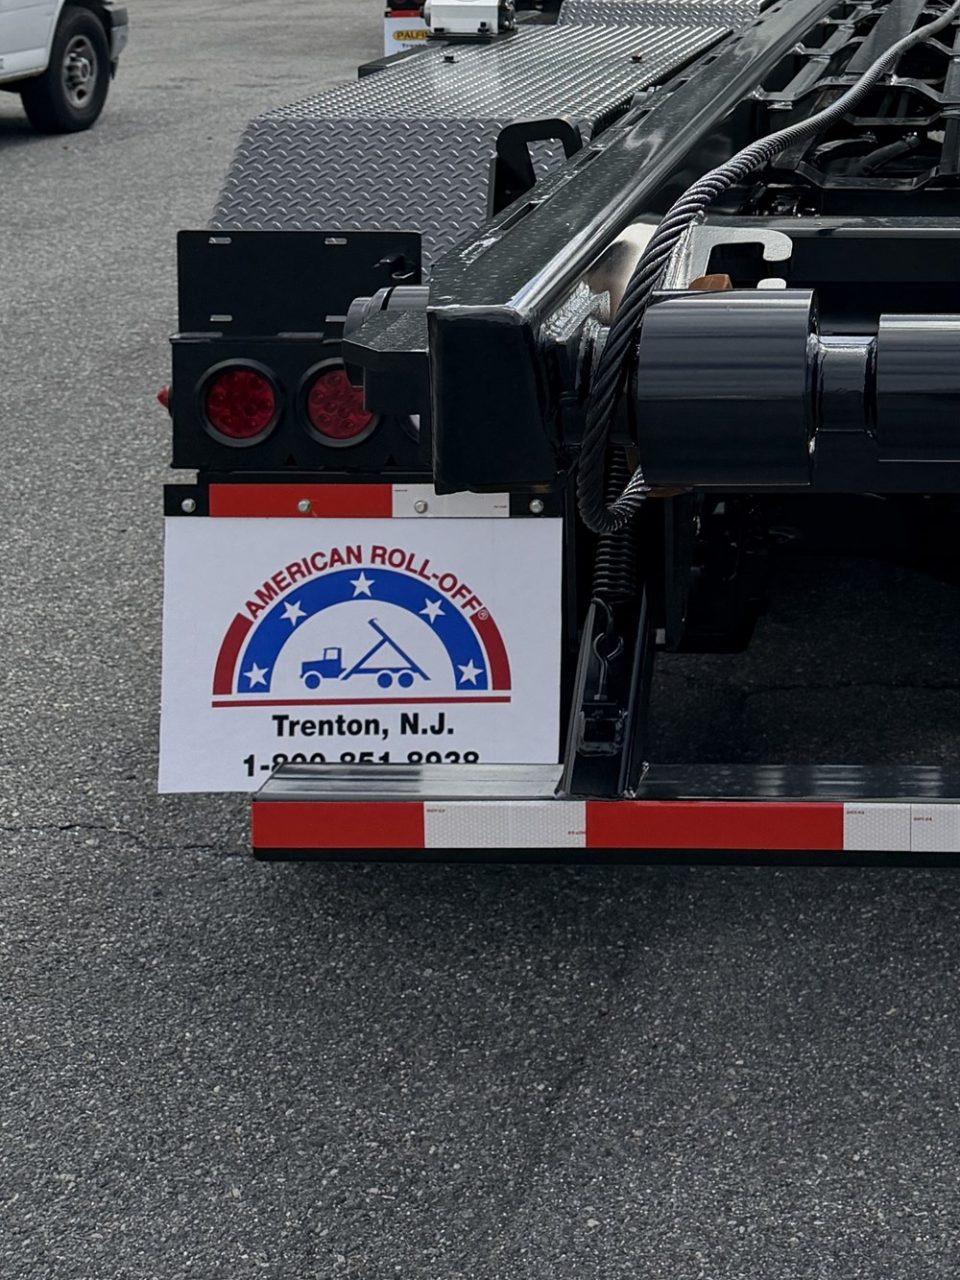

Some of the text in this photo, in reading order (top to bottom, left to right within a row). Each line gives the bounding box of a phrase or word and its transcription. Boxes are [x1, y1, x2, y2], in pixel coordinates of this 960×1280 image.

[245, 545, 362, 619] AMERICAN
[272, 713, 455, 740] Trenton, N.J.
